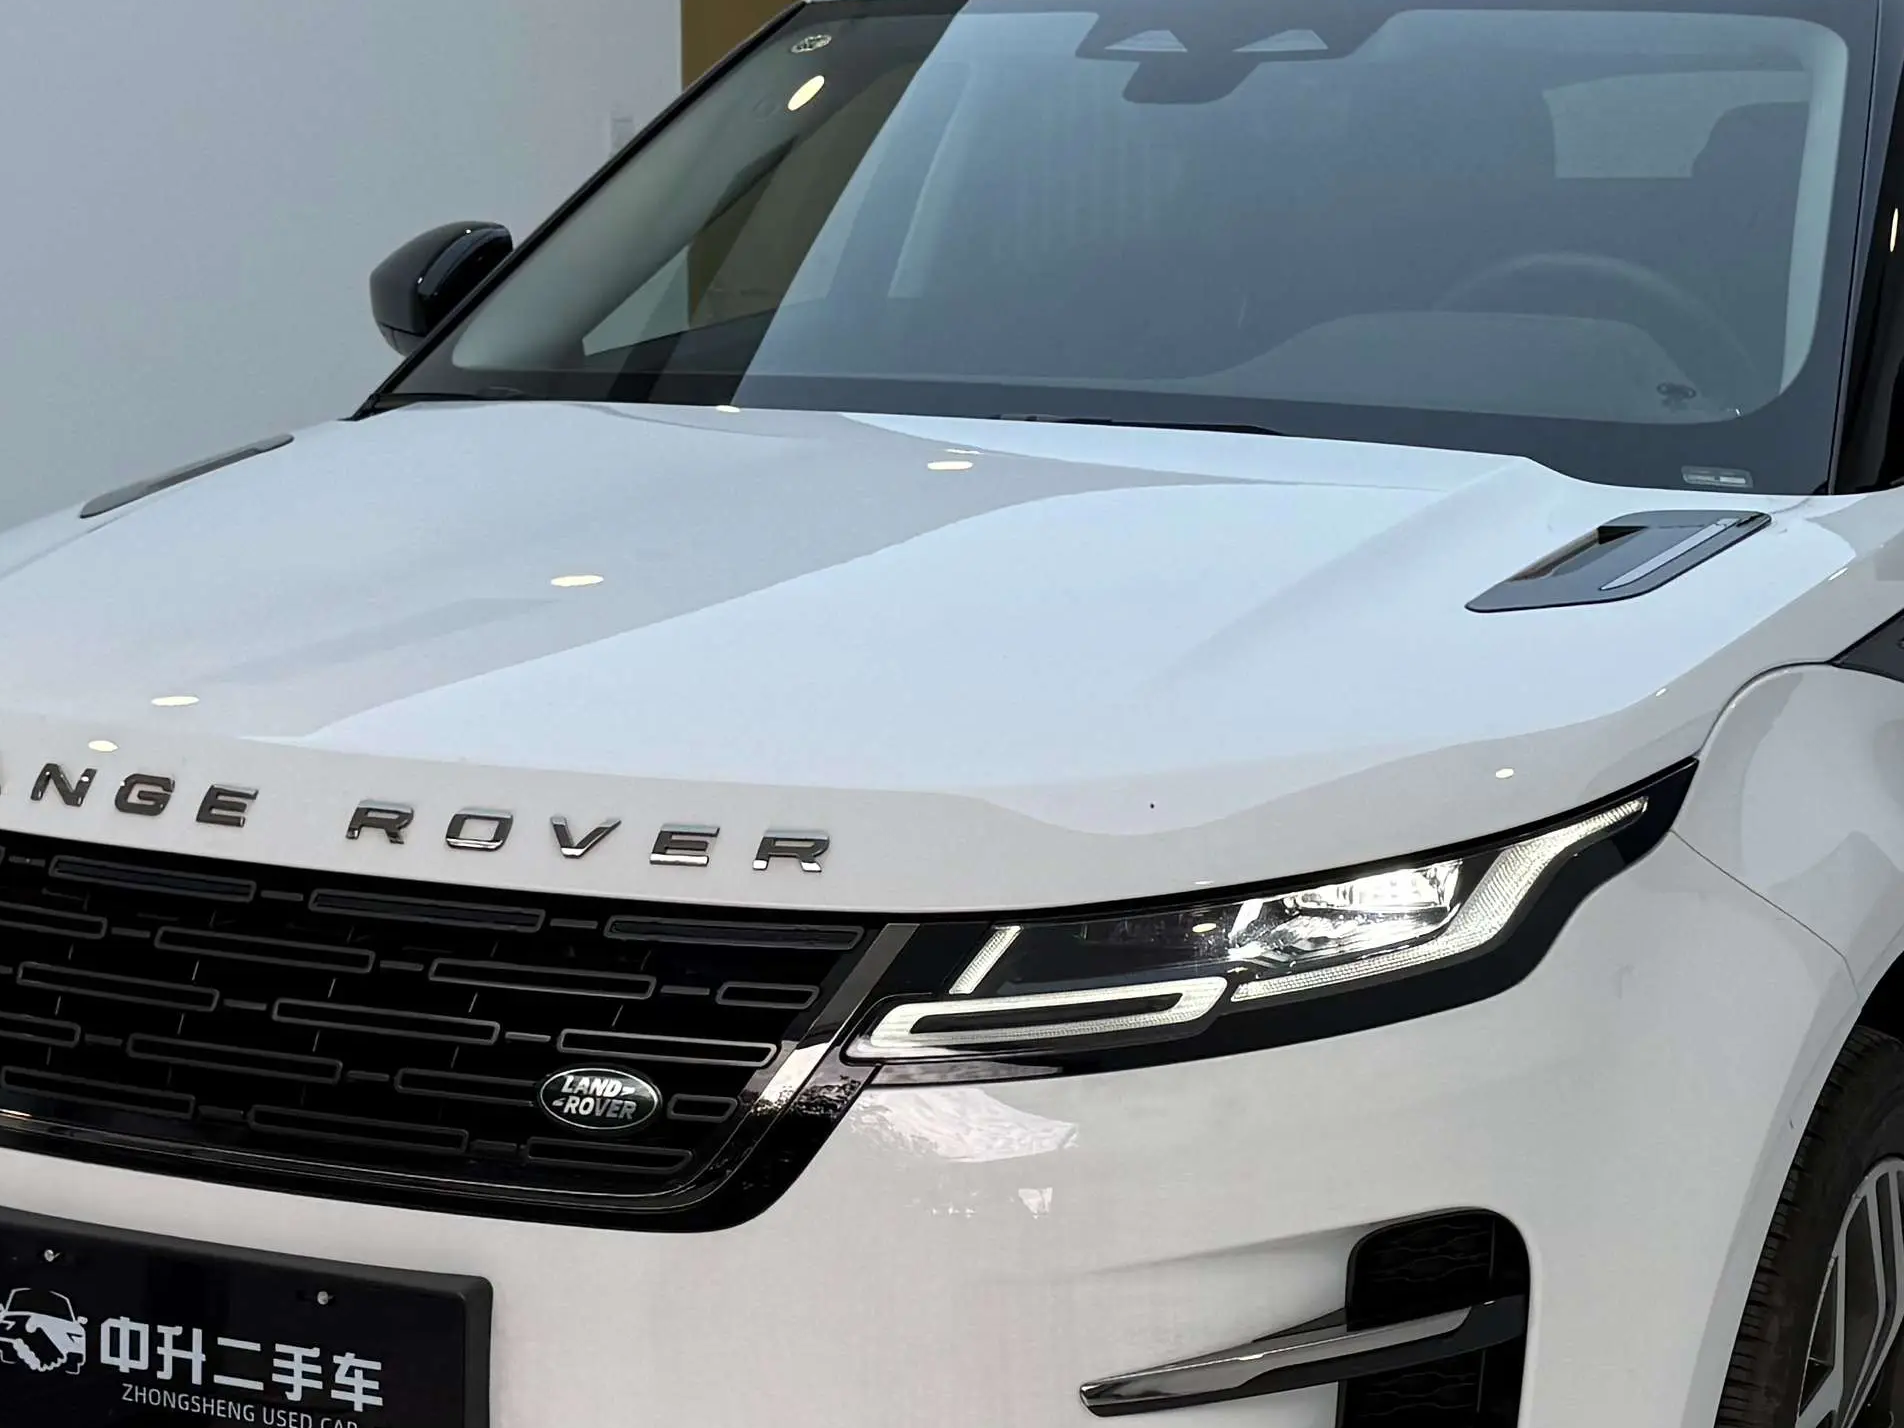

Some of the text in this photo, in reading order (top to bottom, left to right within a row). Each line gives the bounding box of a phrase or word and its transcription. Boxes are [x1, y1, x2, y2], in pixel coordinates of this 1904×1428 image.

[345, 799, 831, 872] ROVER
[100, 1316, 383, 1412] 中升二手车
[121, 1383, 255, 1423] ZHONGSHENG
